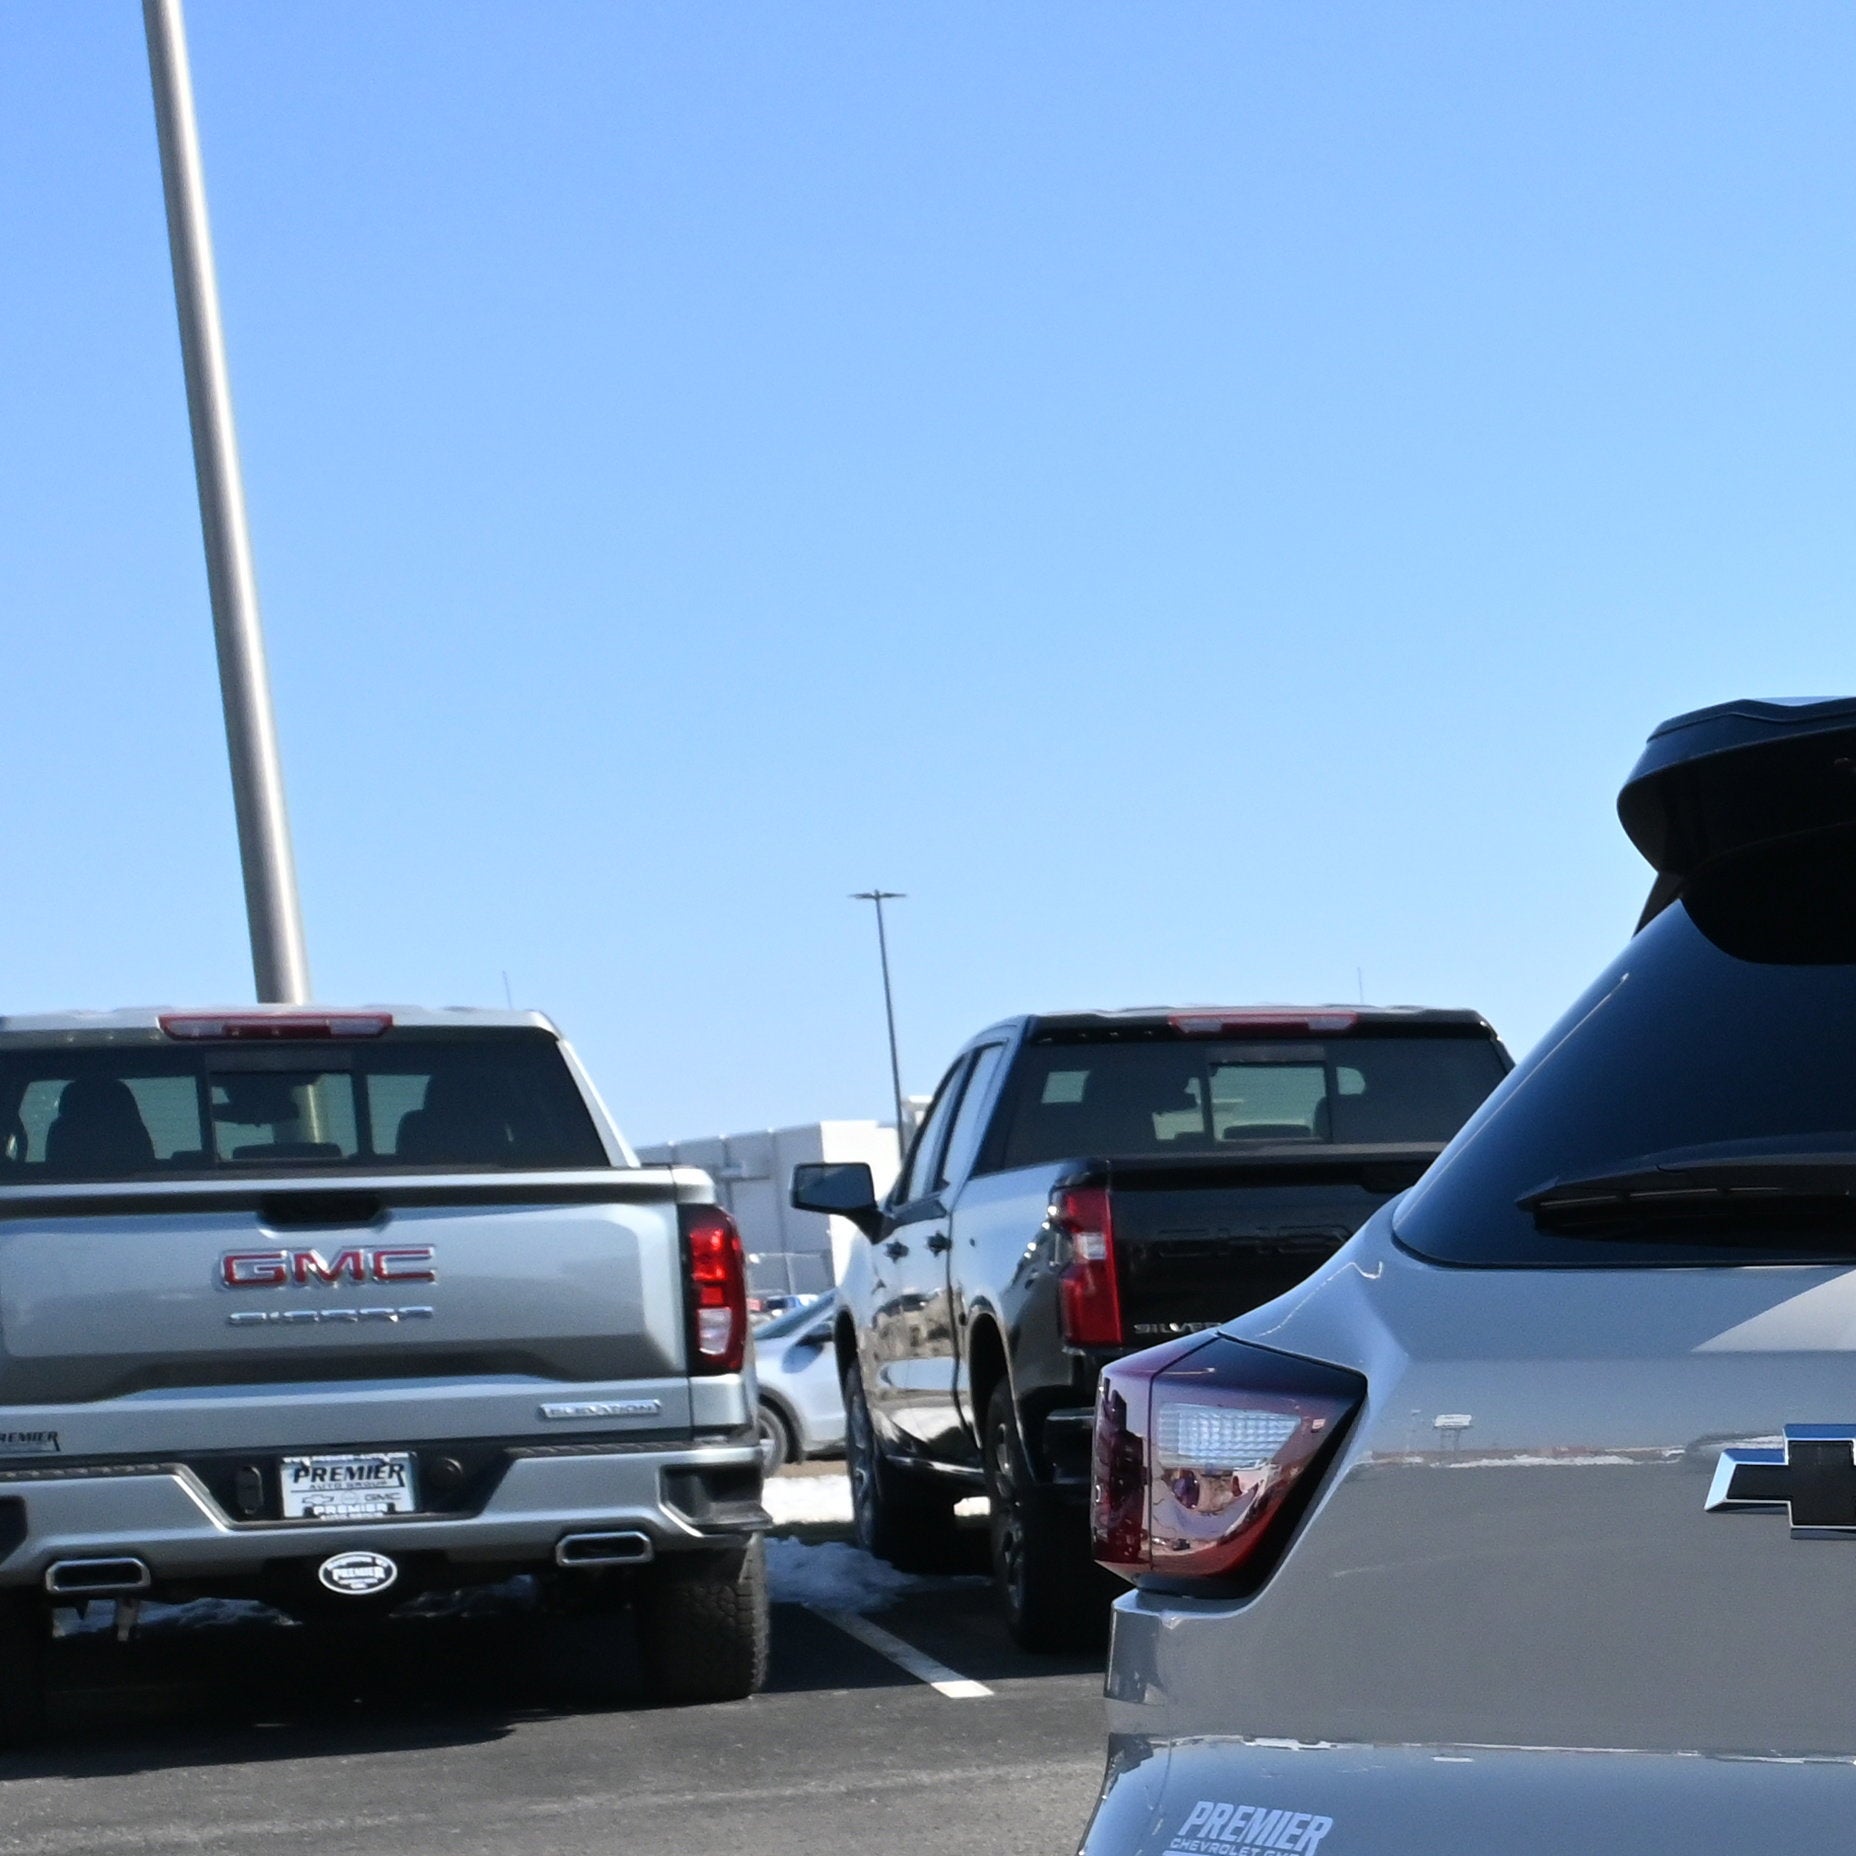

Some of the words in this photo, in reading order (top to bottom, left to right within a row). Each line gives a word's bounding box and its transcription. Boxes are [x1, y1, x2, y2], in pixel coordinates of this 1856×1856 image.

[220, 1247, 439, 1289] GMC
[293, 1462, 405, 1486] PREMIER
[364, 1492, 401, 1502] GMC
